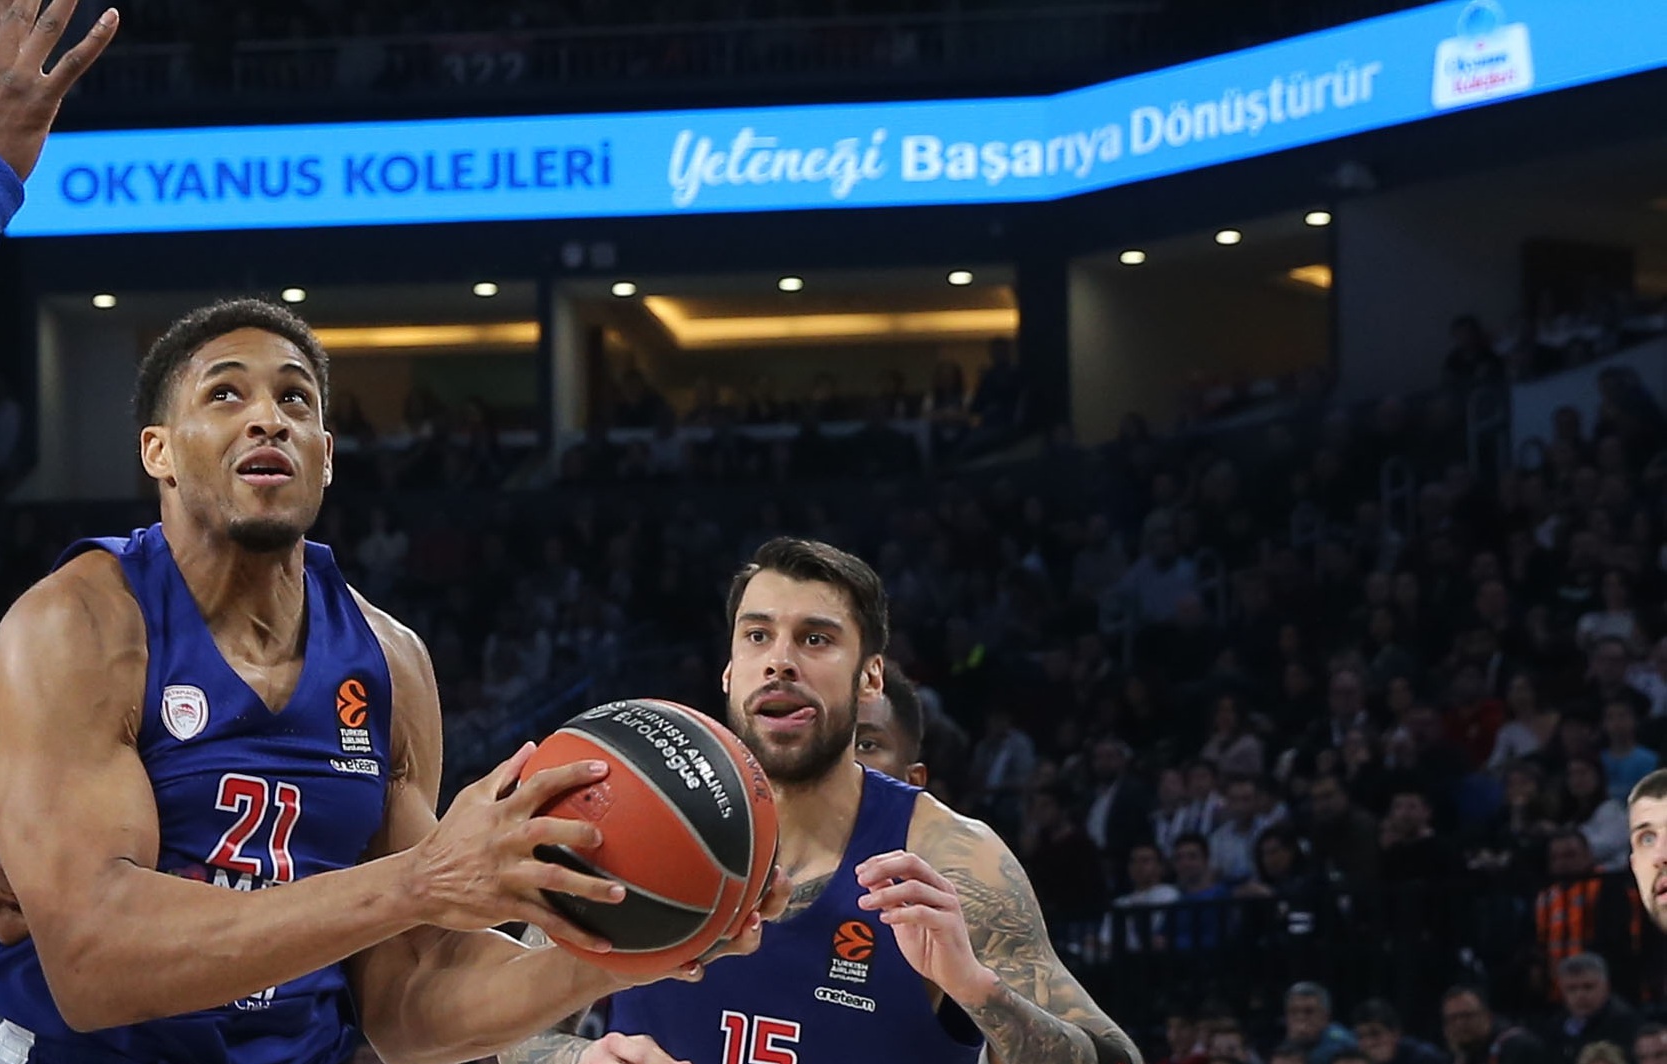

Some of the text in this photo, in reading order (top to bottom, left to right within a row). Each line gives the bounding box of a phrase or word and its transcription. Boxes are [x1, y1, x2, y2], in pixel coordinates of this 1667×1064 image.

[60, 156, 323, 205] OKYANUS
[344, 141, 612, 195] KOLEJLERİ
[901, 122, 1122, 187] Başarıya
[1130, 60, 1383, 156] Dönüştürür
[631, 707, 734, 819] TURKISH AIRLINES
[205, 773, 301, 883] 21
[814, 986, 876, 1013] oneteam
